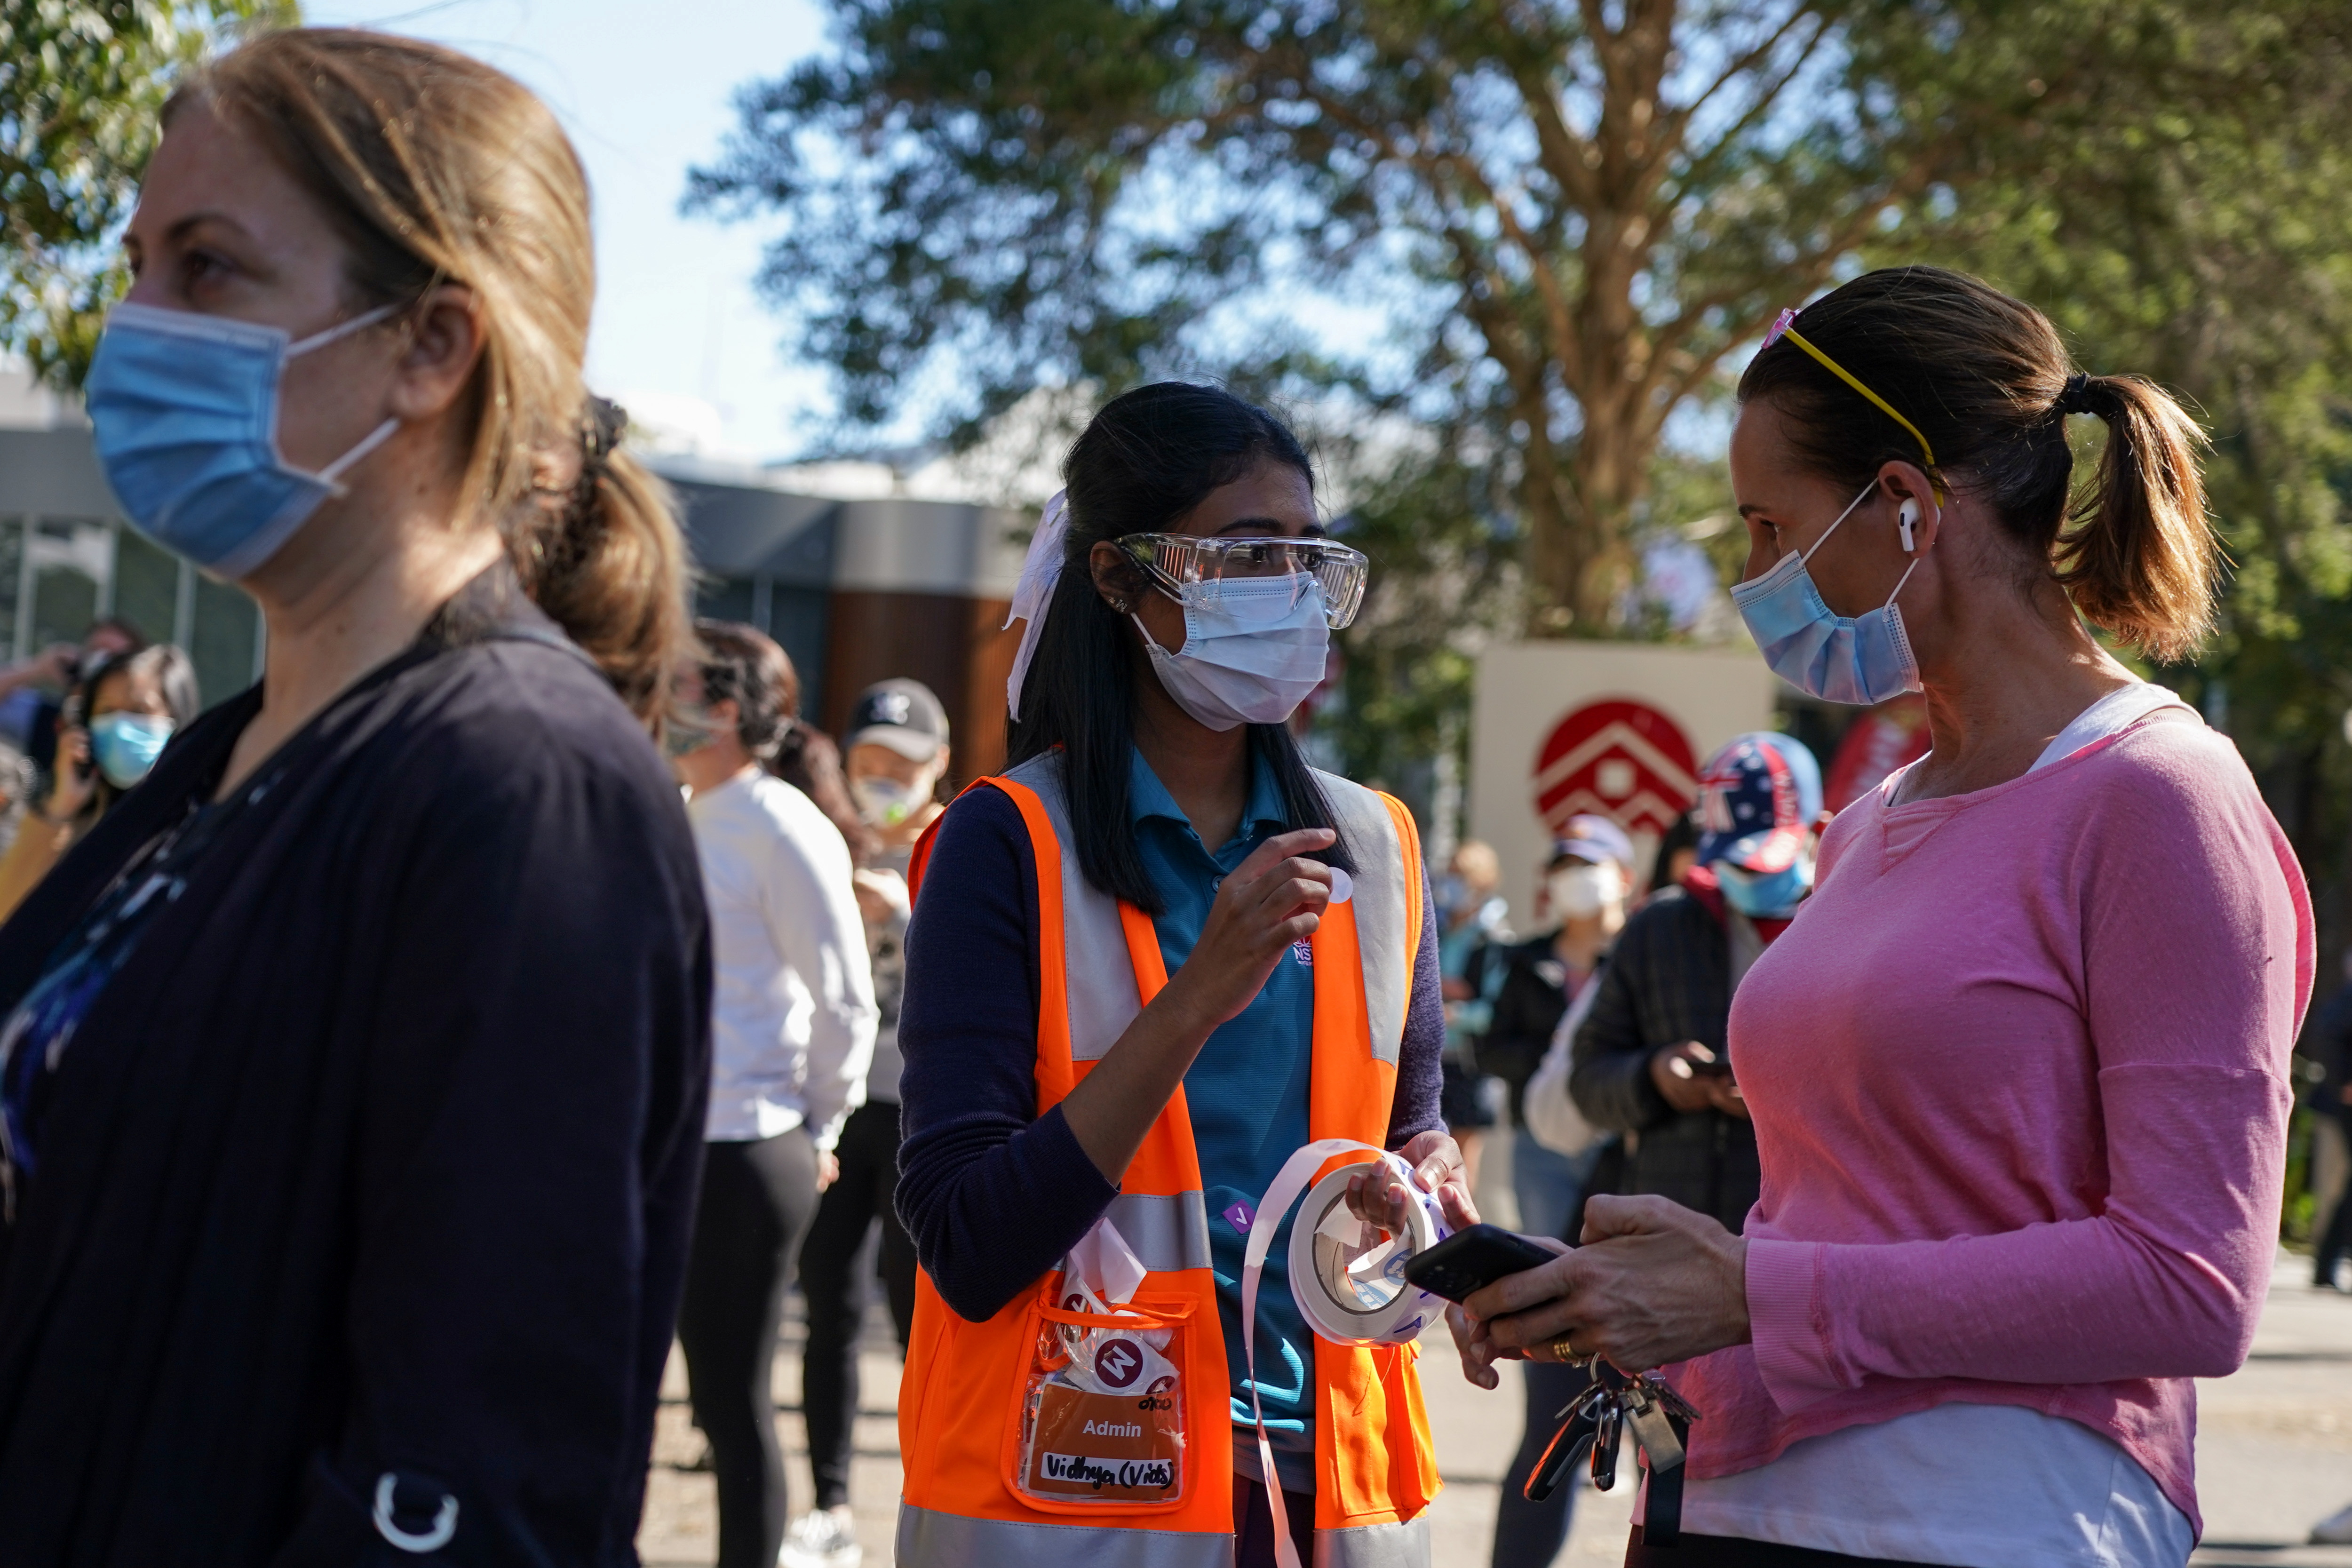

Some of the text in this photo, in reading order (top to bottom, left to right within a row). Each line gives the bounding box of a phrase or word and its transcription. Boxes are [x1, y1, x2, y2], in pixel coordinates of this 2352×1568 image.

[1293, 946, 1312, 961] NS
[1082, 1419, 1141, 1437] Admin
[1047, 1455, 1175, 1489] Vidhya (Vids)
